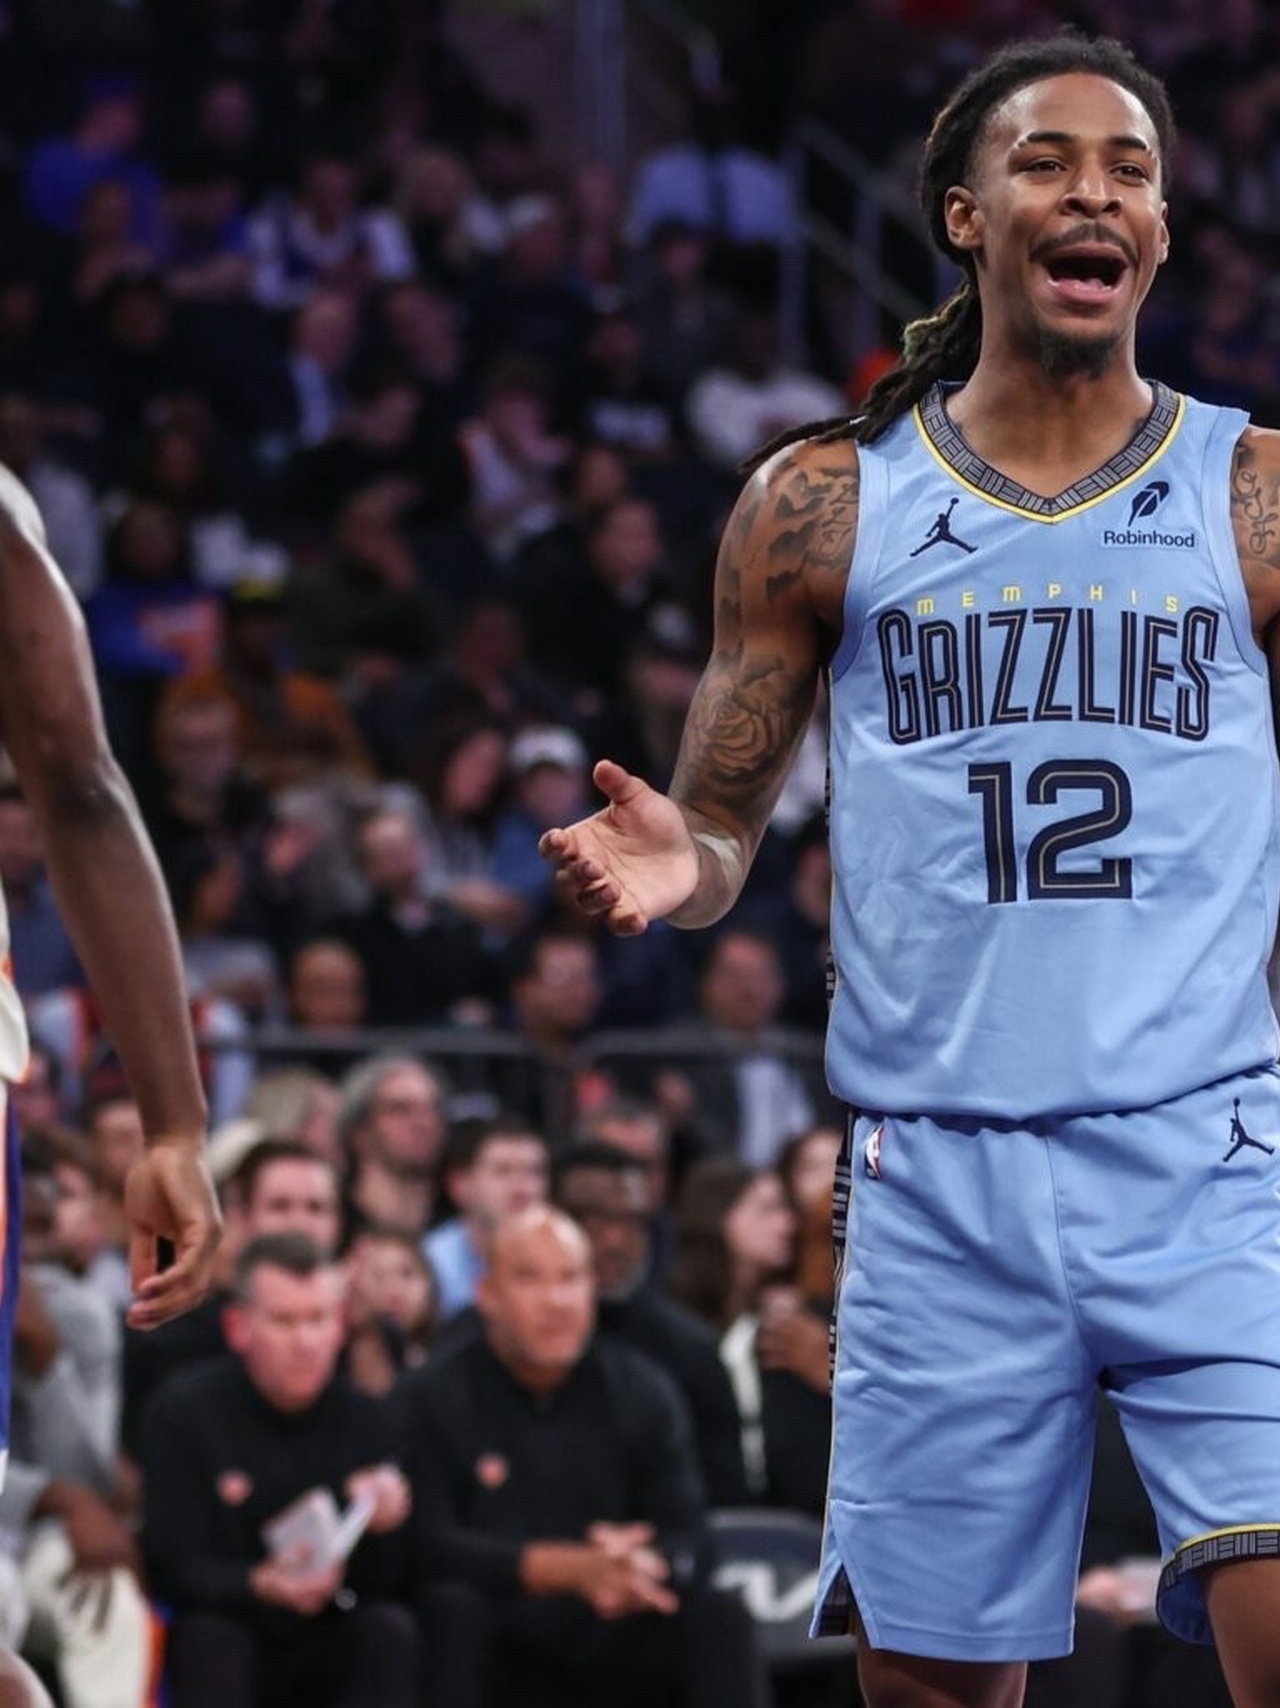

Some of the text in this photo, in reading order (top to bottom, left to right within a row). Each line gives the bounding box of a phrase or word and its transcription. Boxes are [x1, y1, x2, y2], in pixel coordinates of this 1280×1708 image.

[1103, 529, 1196, 549] Robinhood
[916, 583, 1181, 616] MEMPHIS
[876, 605, 1220, 746] GRIZZLIES
[967, 758, 1134, 904] 12
